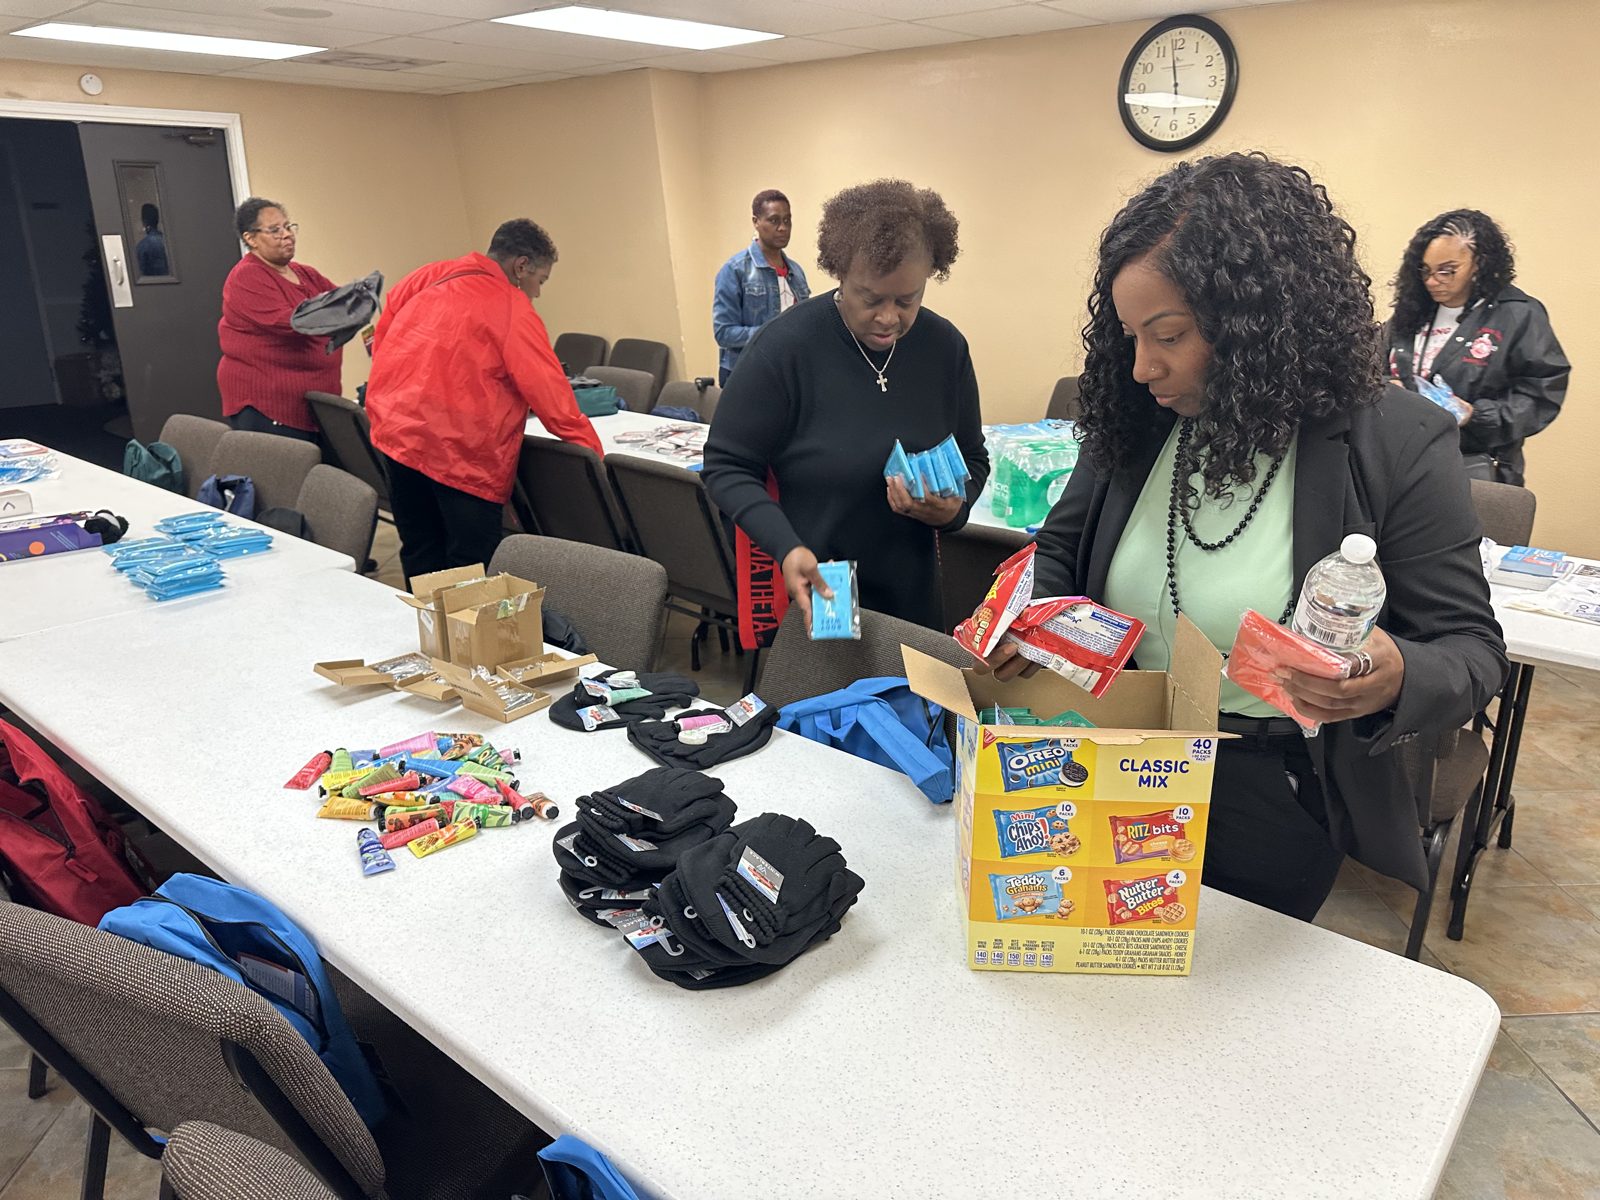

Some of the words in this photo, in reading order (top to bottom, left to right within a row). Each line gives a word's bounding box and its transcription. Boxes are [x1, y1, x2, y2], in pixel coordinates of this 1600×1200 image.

[1174, 38, 1185, 50] 12
[1195, 42, 1200, 54] 1
[1156, 46, 1166, 58] 11
[1205, 55, 1214, 68] 2
[1142, 62, 1154, 74] 10
[1138, 82, 1146, 94] 9
[1208, 76, 1217, 88] 3
[1153, 116, 1160, 127] 7
[1188, 113, 1196, 124] 5
[1169, 120, 1178, 131] 6
[750, 579, 778, 633] THETA
[1192, 738, 1212, 750] 40
[1010, 748, 1064, 769] OREO
[1026, 758, 1060, 776] mini
[1120, 758, 1190, 774] CLASSIC
[1138, 774, 1168, 788] MIX
[1011, 812, 1035, 822] Mini
[1178, 808, 1188, 816] 10
[1008, 821, 1041, 842] Chips
[1127, 824, 1151, 839] RITZ
[1152, 824, 1179, 835] bits
[1006, 875, 1044, 888] Teddy
[1006, 884, 1046, 895] Grahams
[1118, 878, 1158, 901] Nutter
[1126, 886, 1164, 910] Butter
[1136, 896, 1164, 916] Bites
